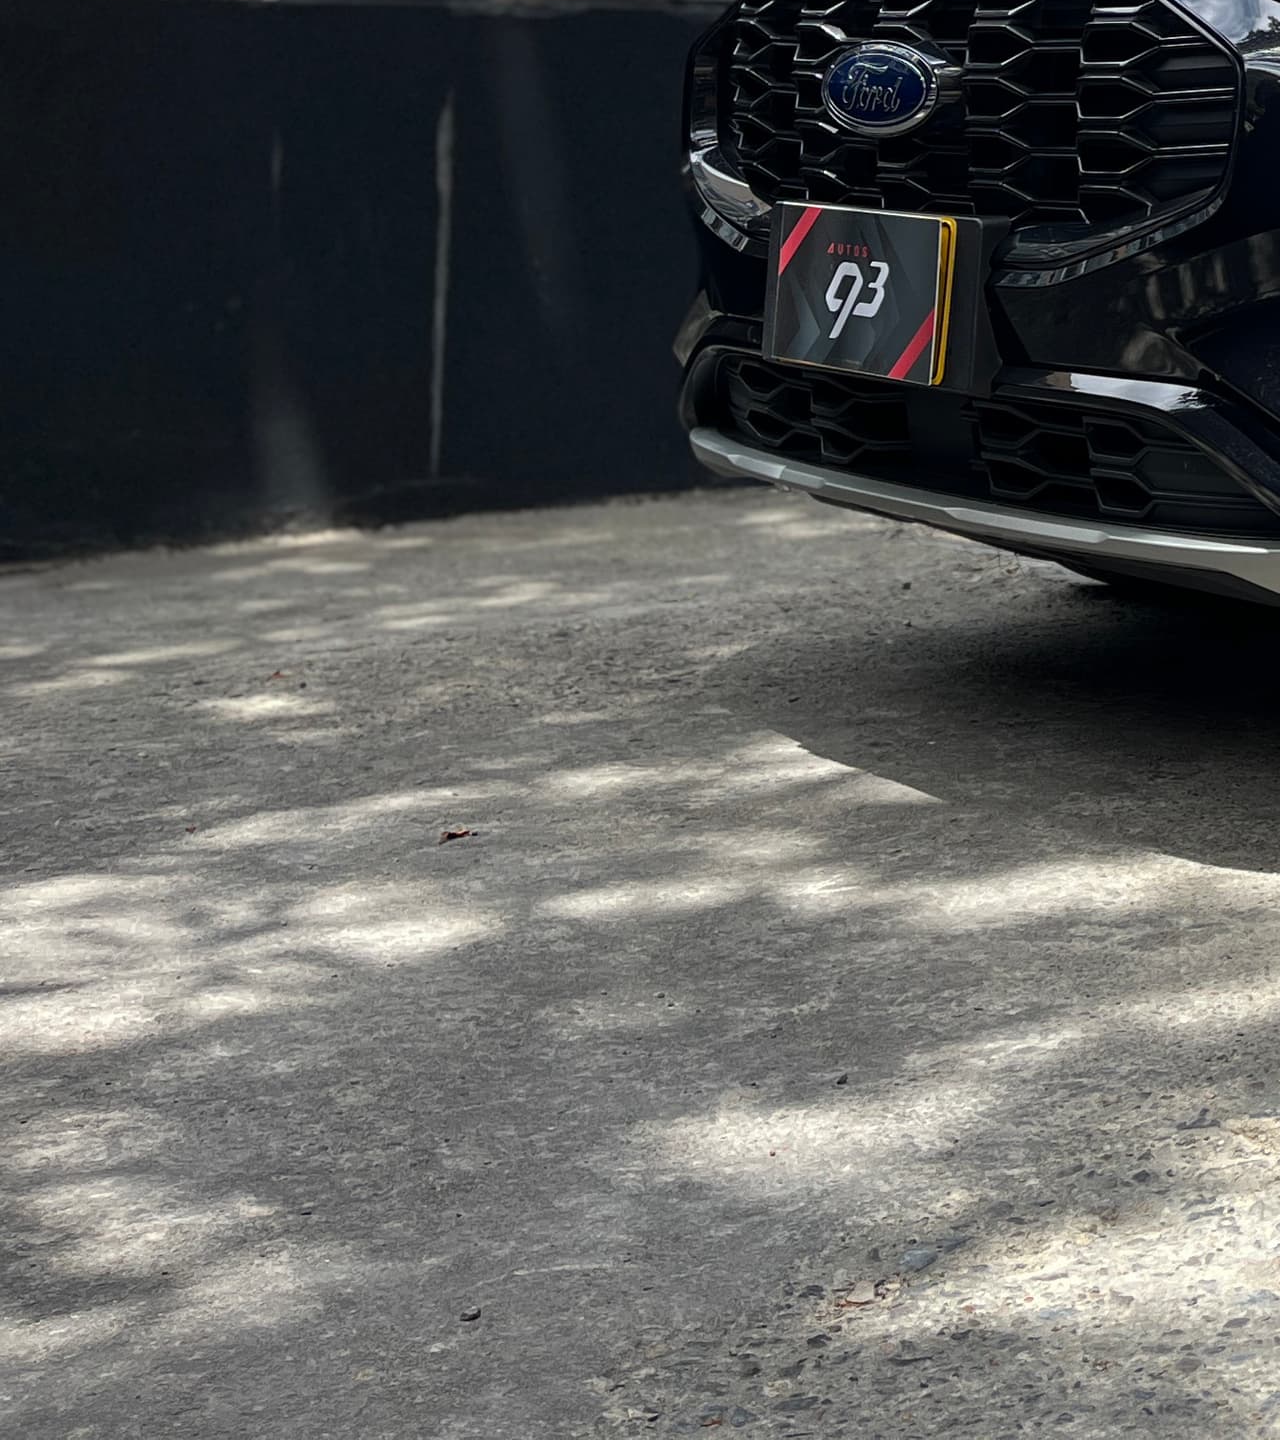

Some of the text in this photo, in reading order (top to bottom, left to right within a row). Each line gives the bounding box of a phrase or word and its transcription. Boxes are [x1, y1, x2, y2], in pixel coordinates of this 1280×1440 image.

[842, 61, 904, 113] Ford
[826, 242, 869, 258] AUTOS
[825, 261, 890, 340] 93
